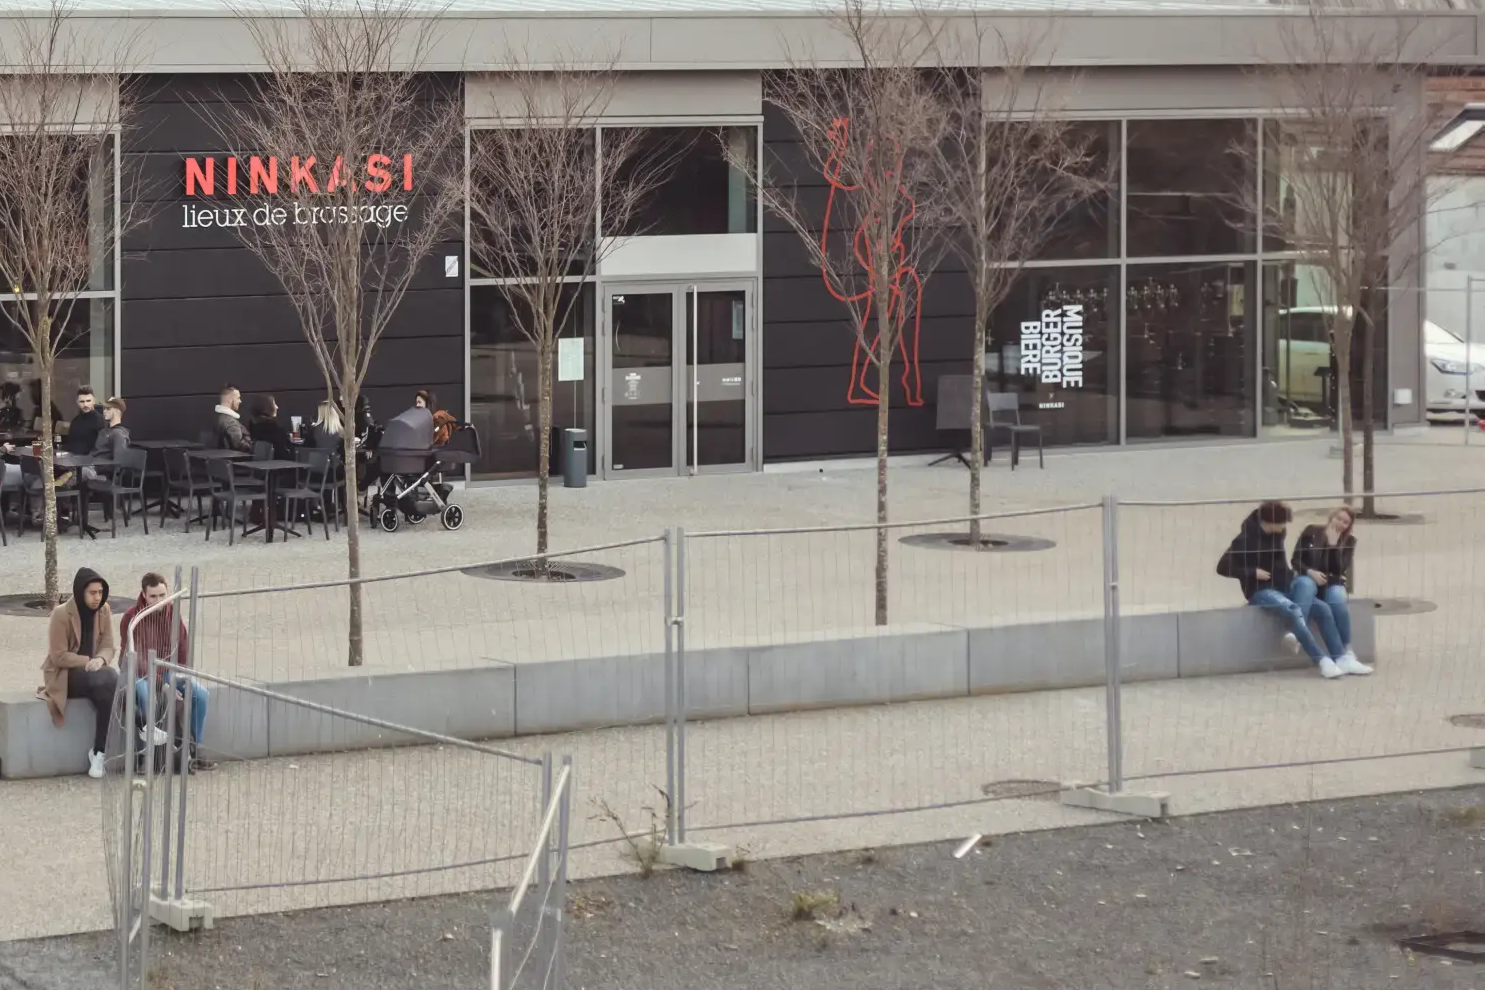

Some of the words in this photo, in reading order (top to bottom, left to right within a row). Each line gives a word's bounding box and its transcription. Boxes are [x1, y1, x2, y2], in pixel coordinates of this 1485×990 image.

[185, 154, 413, 196] NINKASI
[182, 204, 248, 228] lieux
[253, 203, 288, 227] de
[1020, 321, 1041, 375] BIERE
[1041, 308, 1062, 384] BURGER
[1062, 304, 1083, 389] MUSIQUE
